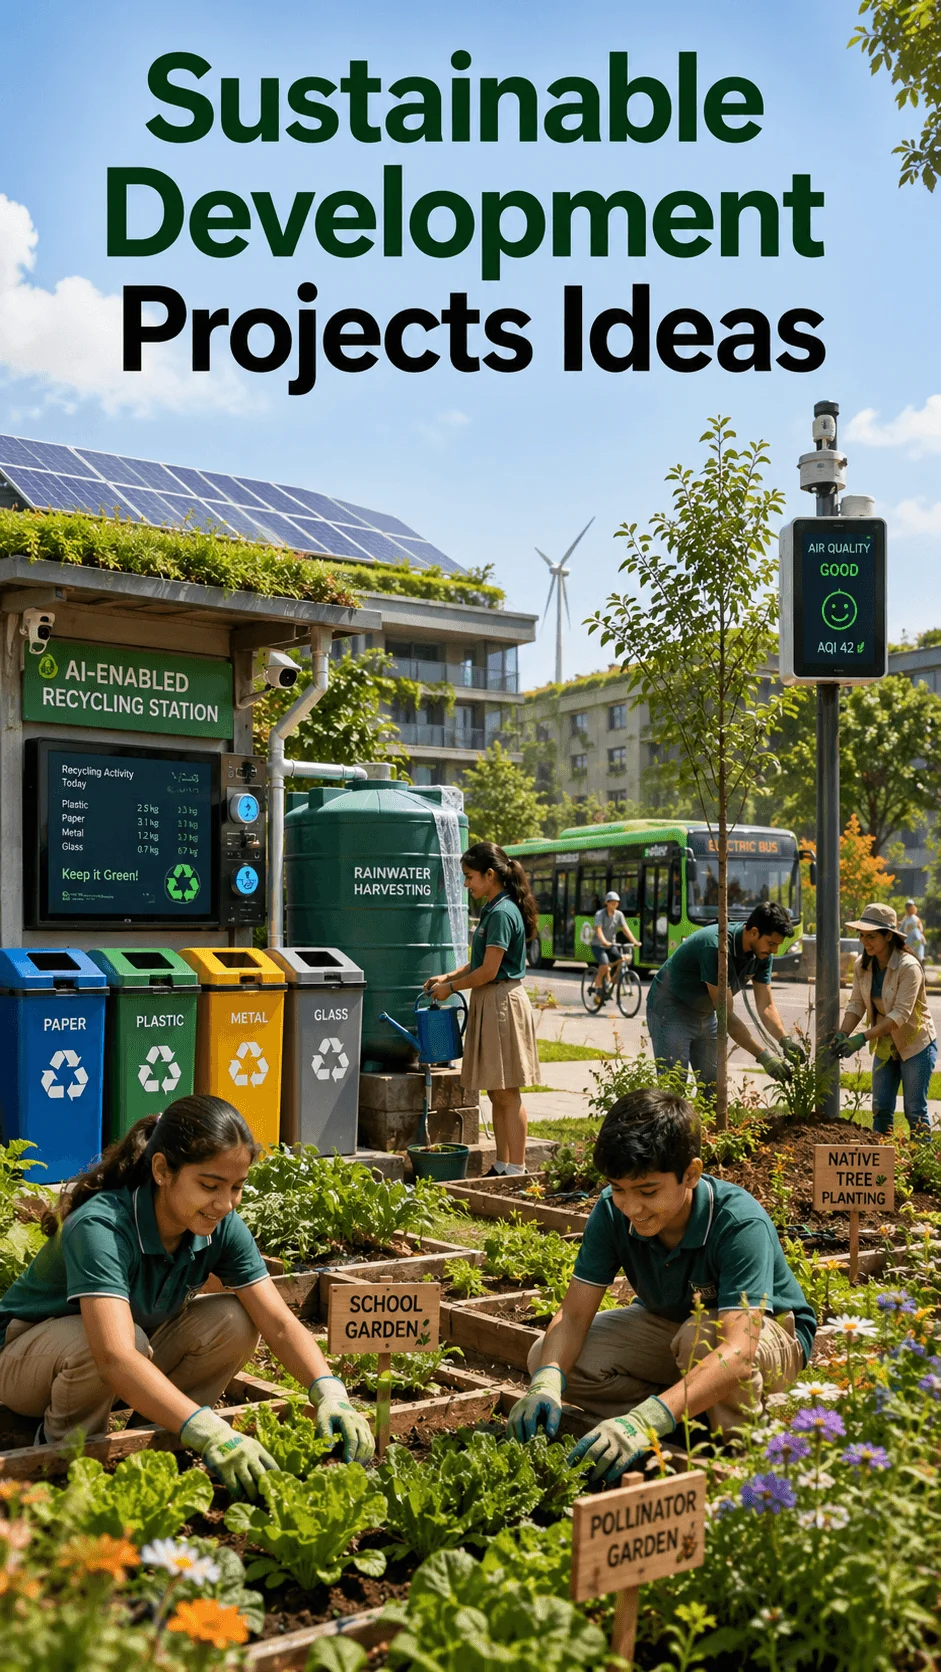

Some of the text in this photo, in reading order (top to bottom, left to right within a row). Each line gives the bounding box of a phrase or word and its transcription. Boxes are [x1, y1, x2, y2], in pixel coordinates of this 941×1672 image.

[808, 543, 871, 554] AIR QUALITY
[820, 563, 859, 577] GOOD
[817, 641, 854, 655] AQI 42
[65, 660, 189, 693] AI-ENABLED
[42, 687, 219, 723] RECYCLING STATION
[62, 764, 134, 780] Recycling Activity
[62, 778, 87, 790] Today
[62, 799, 89, 810] Plastic
[137, 804, 149, 812] 25
[62, 813, 85, 824] Paper
[137, 818, 148, 826] 31
[62, 828, 84, 838] Metal
[137, 831, 149, 840] 12
[62, 842, 84, 851] Glass
[708, 840, 779, 853] ELCTRIC BUS
[62, 868, 139, 882] Keep it Green!
[354, 866, 431, 880] RAINWATER
[354, 883, 431, 896] HARVESTING
[136, 1014, 185, 1028] PLASTIC
[231, 1011, 268, 1025] METAL
[314, 1008, 349, 1022] GLASS
[43, 1017, 87, 1032] PAPER
[828, 1152, 880, 1167] NATIVE
[836, 1172, 873, 1187] TREE
[821, 1191, 886, 1205] PLANTING
[349, 1294, 423, 1313] SCHOOL
[345, 1320, 419, 1339] GARDEN
[590, 1490, 697, 1539] POLLINATOR
[607, 1528, 679, 1568] GARDEN
